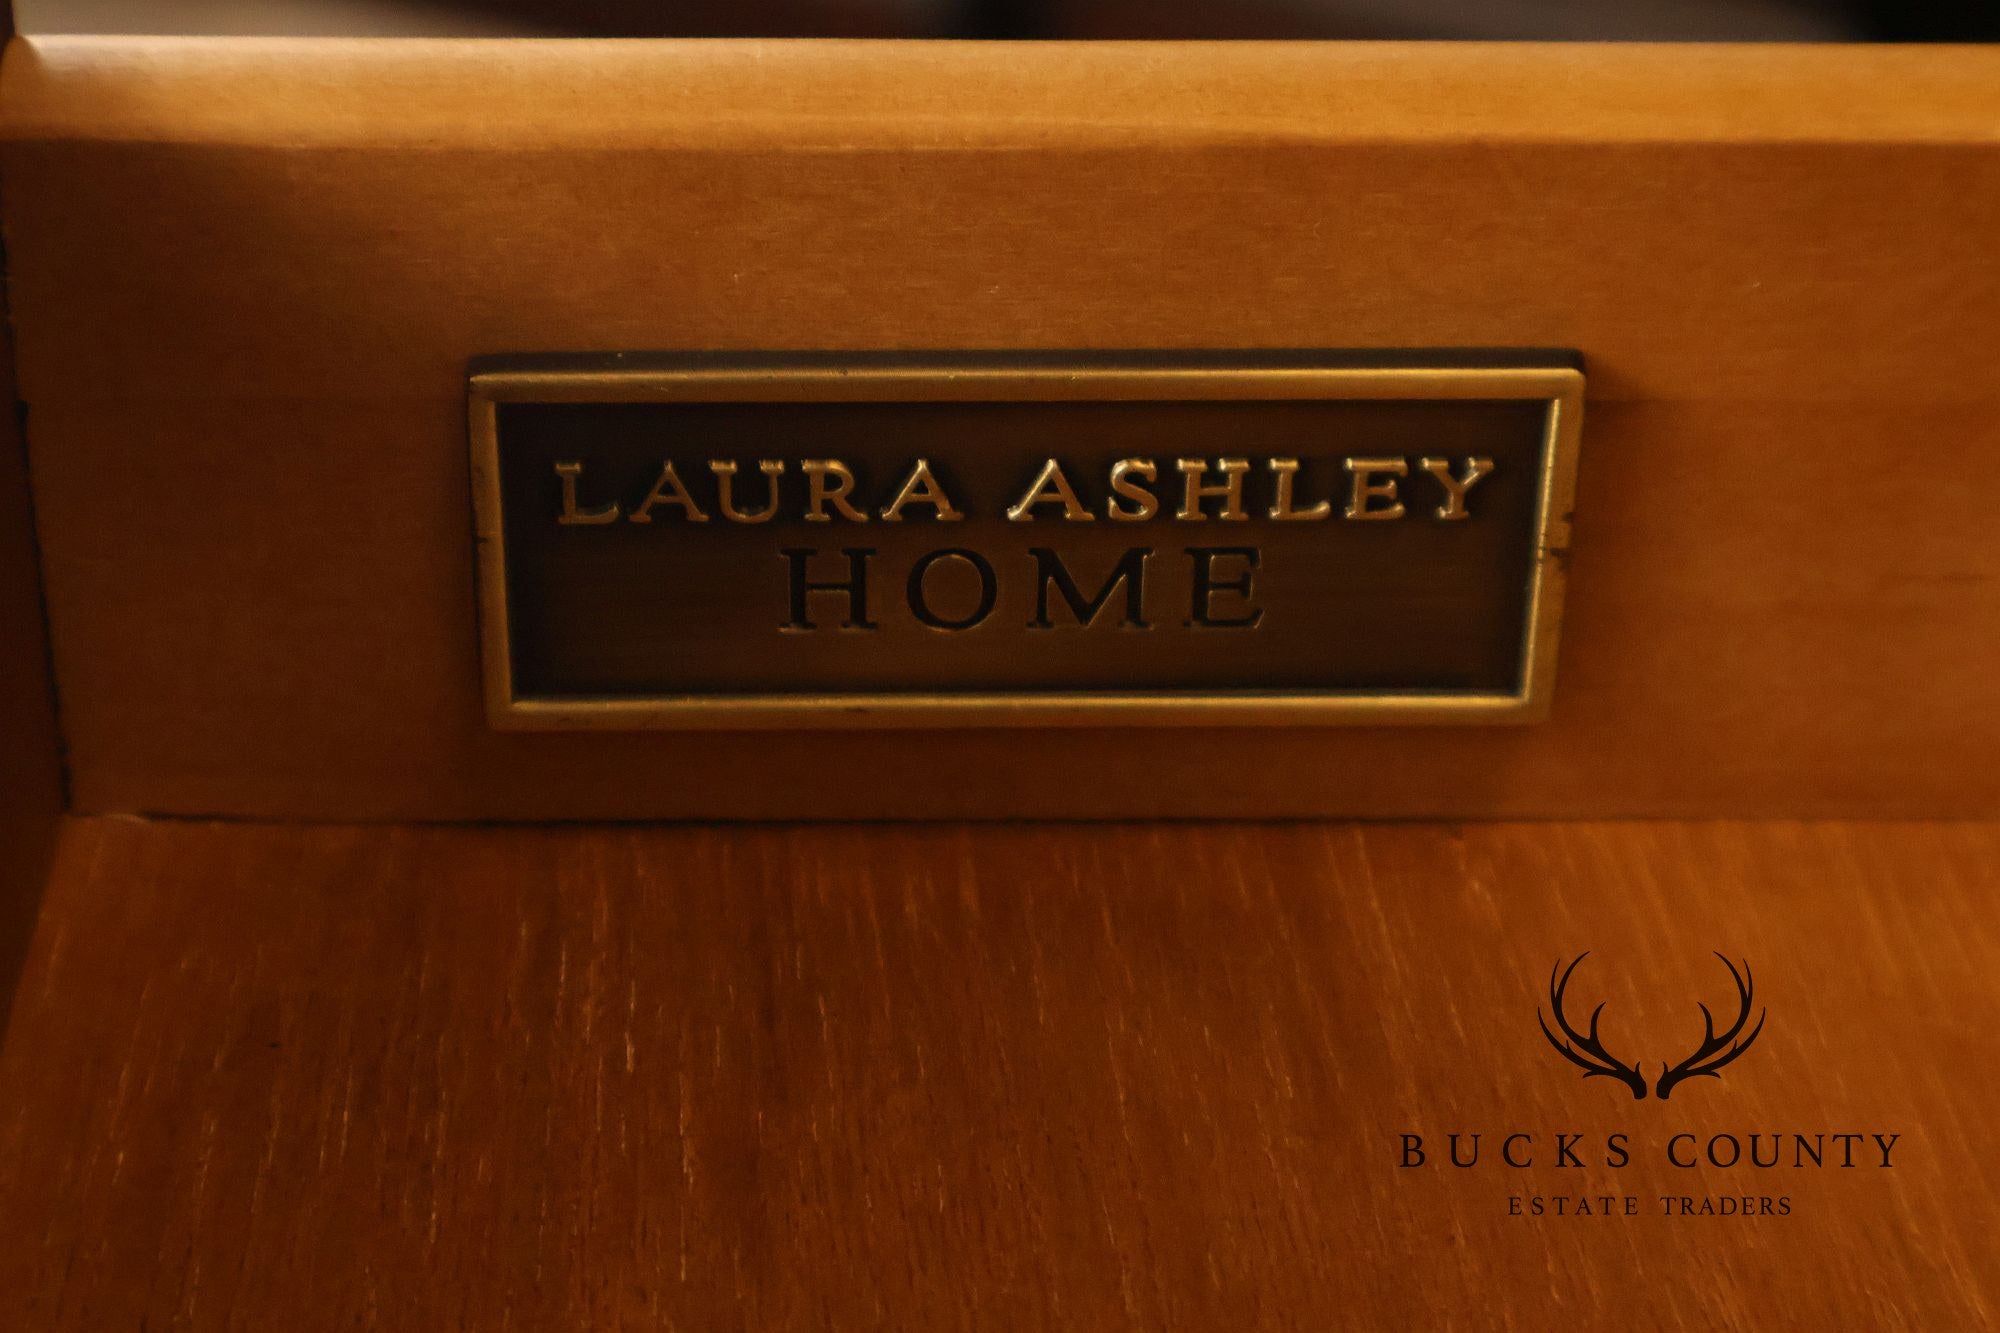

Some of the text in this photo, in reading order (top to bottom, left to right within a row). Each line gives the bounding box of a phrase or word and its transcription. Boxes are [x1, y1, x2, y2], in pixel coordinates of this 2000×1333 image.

[555, 455, 1496, 526] LAURA ASHLEY
[777, 545, 1267, 634] HOME
